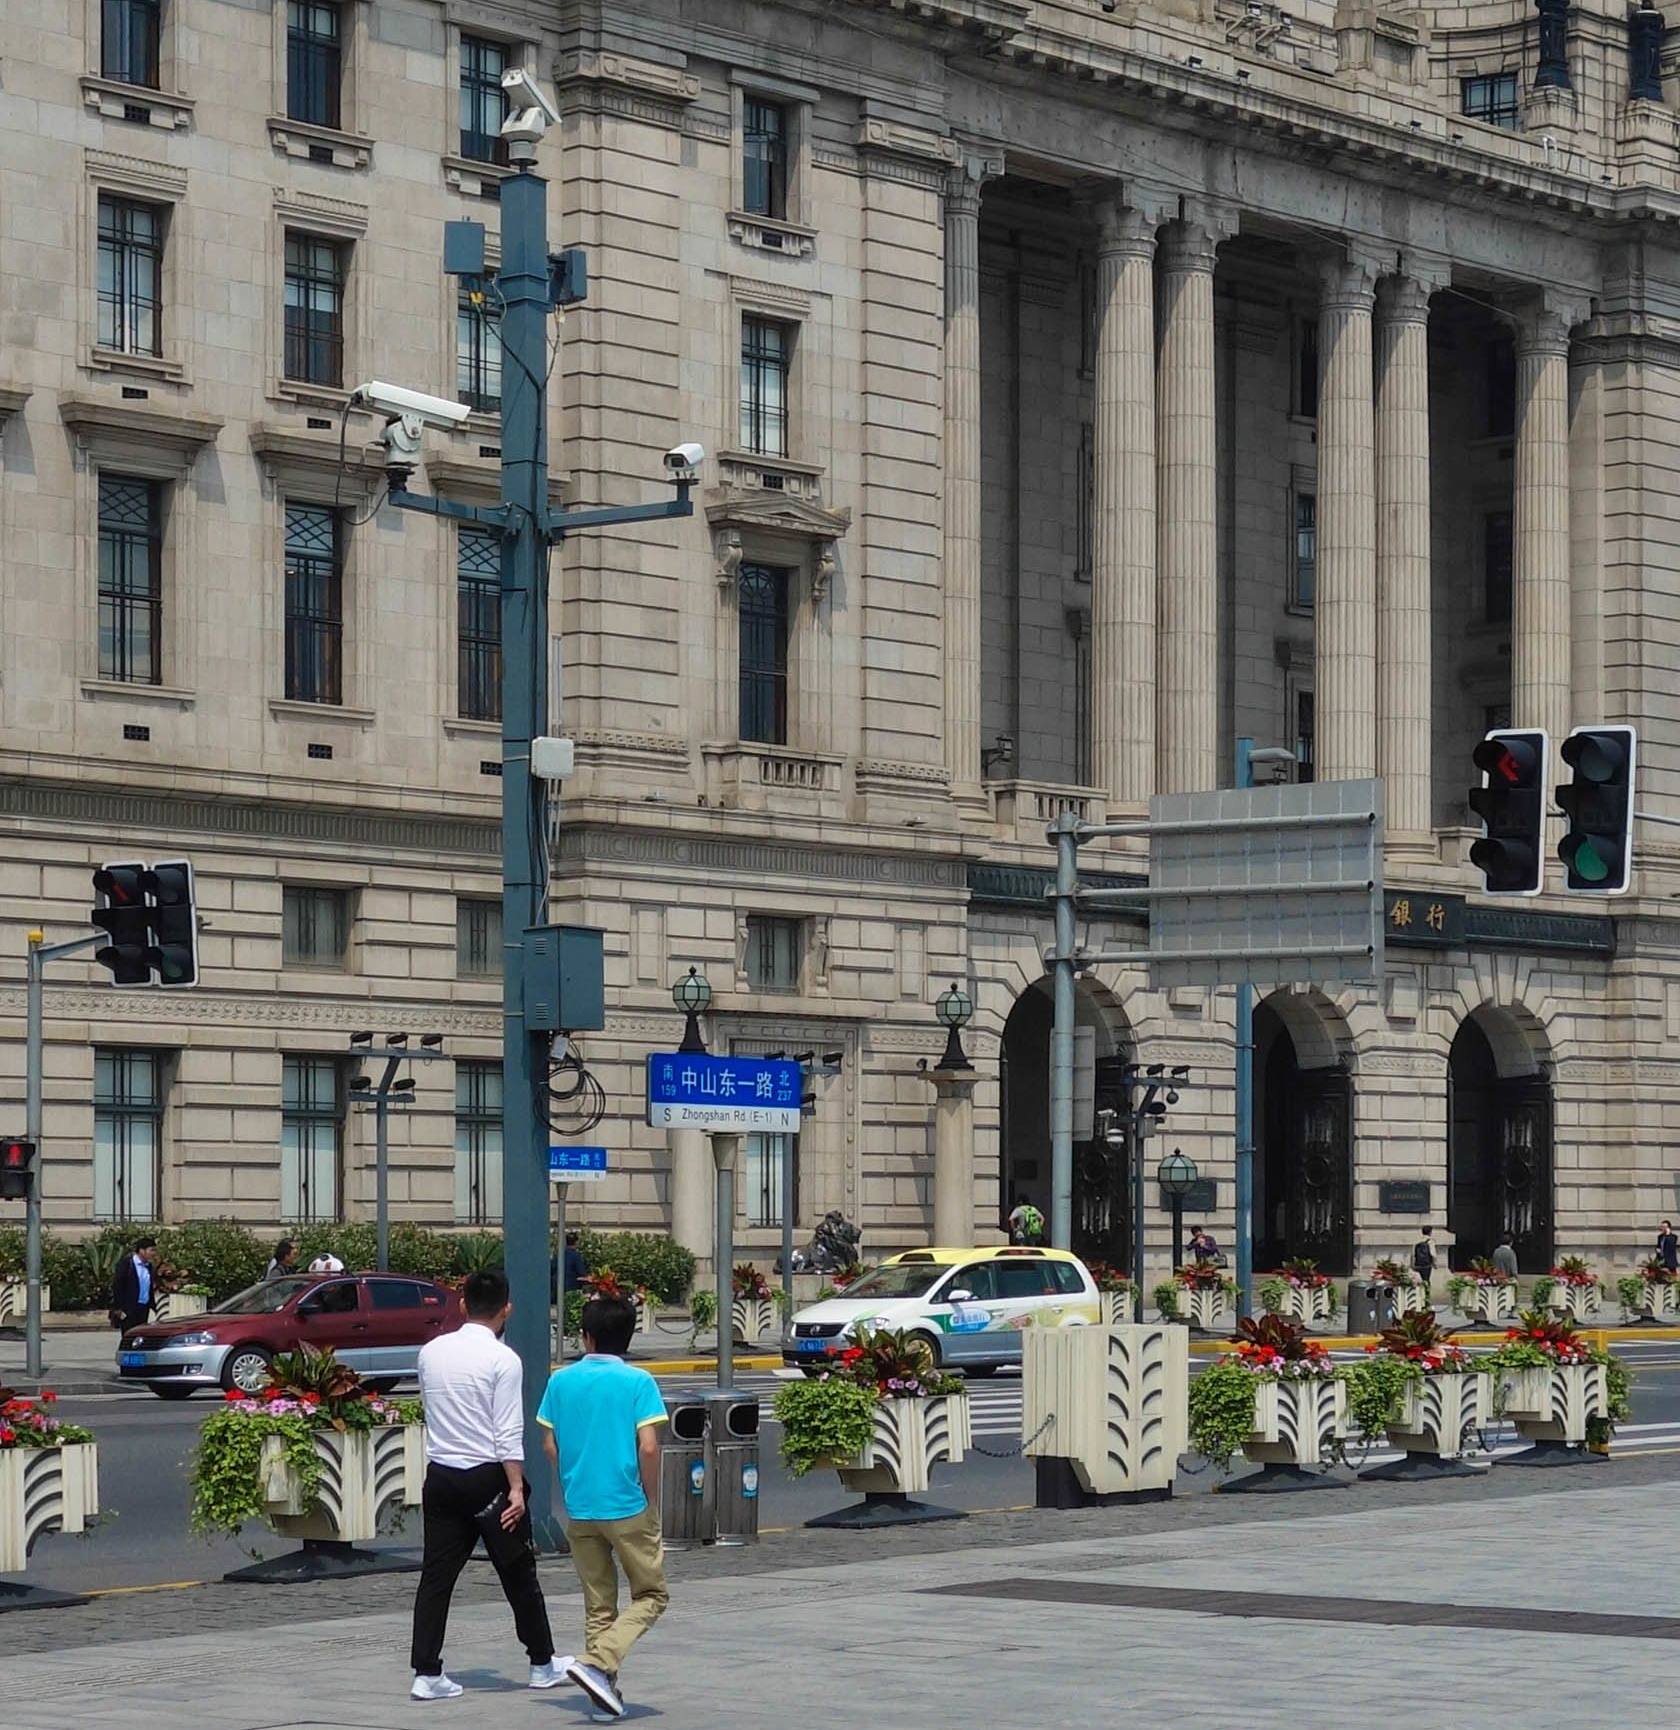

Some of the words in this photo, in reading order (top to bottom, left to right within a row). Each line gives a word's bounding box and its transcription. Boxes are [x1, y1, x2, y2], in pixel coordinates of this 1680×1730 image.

[663, 1063, 674, 1082] 南
[681, 1065, 774, 1098] 中山东一路
[778, 1070, 791, 1087] 北
[661, 1084, 676, 1097] 159
[776, 1089, 792, 1102] 237
[663, 1107, 672, 1123] S
[681, 1107, 730, 1124] Zhongshan
[780, 1112, 789, 1127] N
